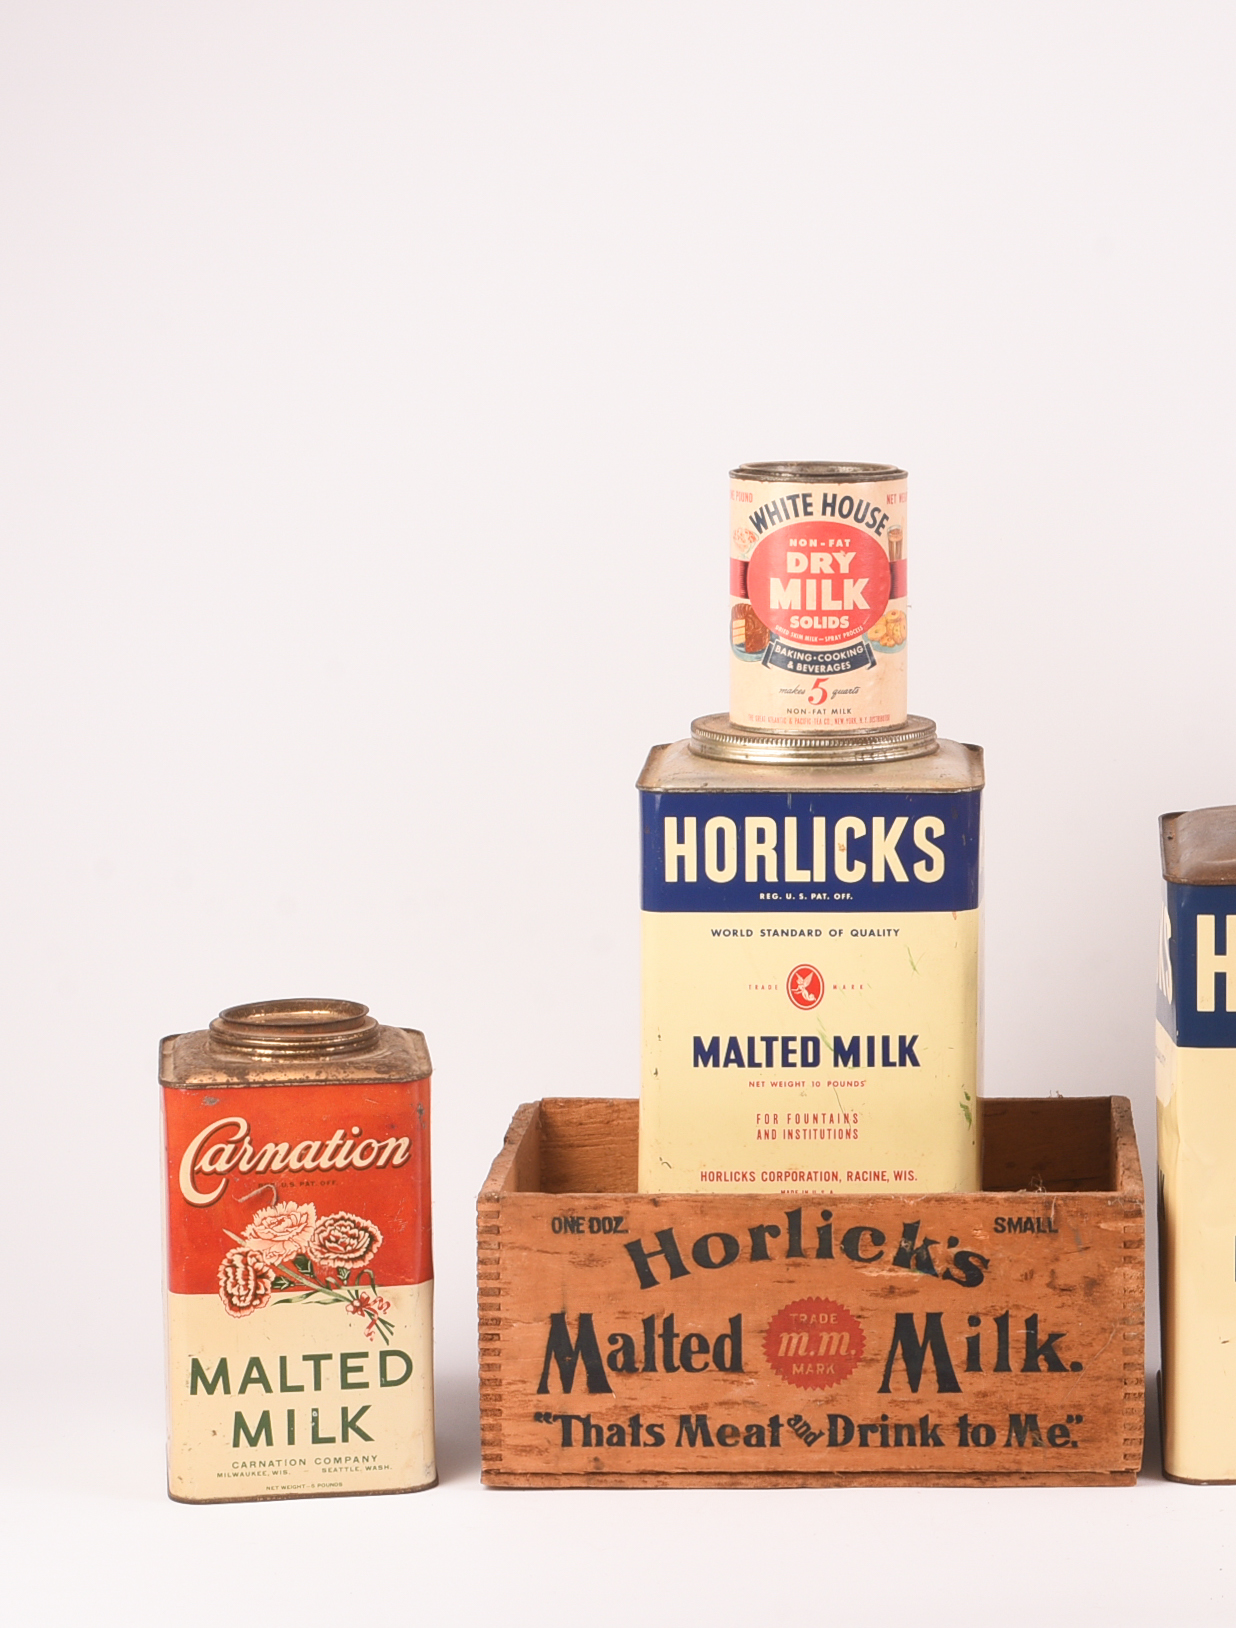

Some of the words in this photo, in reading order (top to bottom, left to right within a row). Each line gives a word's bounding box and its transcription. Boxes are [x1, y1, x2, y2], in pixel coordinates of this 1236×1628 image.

[749, 493, 814, 535] WHITE
[821, 493, 890, 537] HOUSE
[787, 551, 856, 574] DRY
[770, 578, 870, 611] MILK
[790, 615, 850, 629] SOLIDS
[786, 661, 794, 670] &
[796, 661, 851, 673] BEVERAGES
[779, 684, 805, 695] makes
[808, 678, 829, 705] 5
[664, 815, 945, 883] HORLICKS
[711, 928, 754, 938] WORLD
[759, 928, 823, 938] STANDARD
[827, 928, 845, 938] OF
[850, 929, 900, 938] QUALITY
[693, 1036, 821, 1068] MALTED
[833, 1035, 921, 1068] MILK
[179, 1117, 411, 1206] Carnation
[700, 1170, 755, 1182] HORLICKS
[761, 1170, 842, 1183] CORPORATION,
[893, 1170, 918, 1181] WIS.
[551, 1216, 584, 1234] ONE
[993, 1216, 1059, 1234] SMALL
[623, 1207, 990, 1290] Horlick's
[789, 1313, 838, 1326] TRADE
[537, 1312, 744, 1394] Malted
[878, 1308, 1084, 1394] Milk.
[190, 1350, 413, 1395] MALTED
[791, 1363, 836, 1376] MARK
[233, 1405, 375, 1448] MILK
[676, 1413, 781, 1449] Meat
[787, 1413, 825, 1448] and
[827, 1413, 945, 1448] Drink
[957, 1414, 996, 1448] to
[232, 1459, 306, 1469] CARNATION
[315, 1455, 378, 1465] COMPANY
[271, 1469, 292, 1477] WIS.
